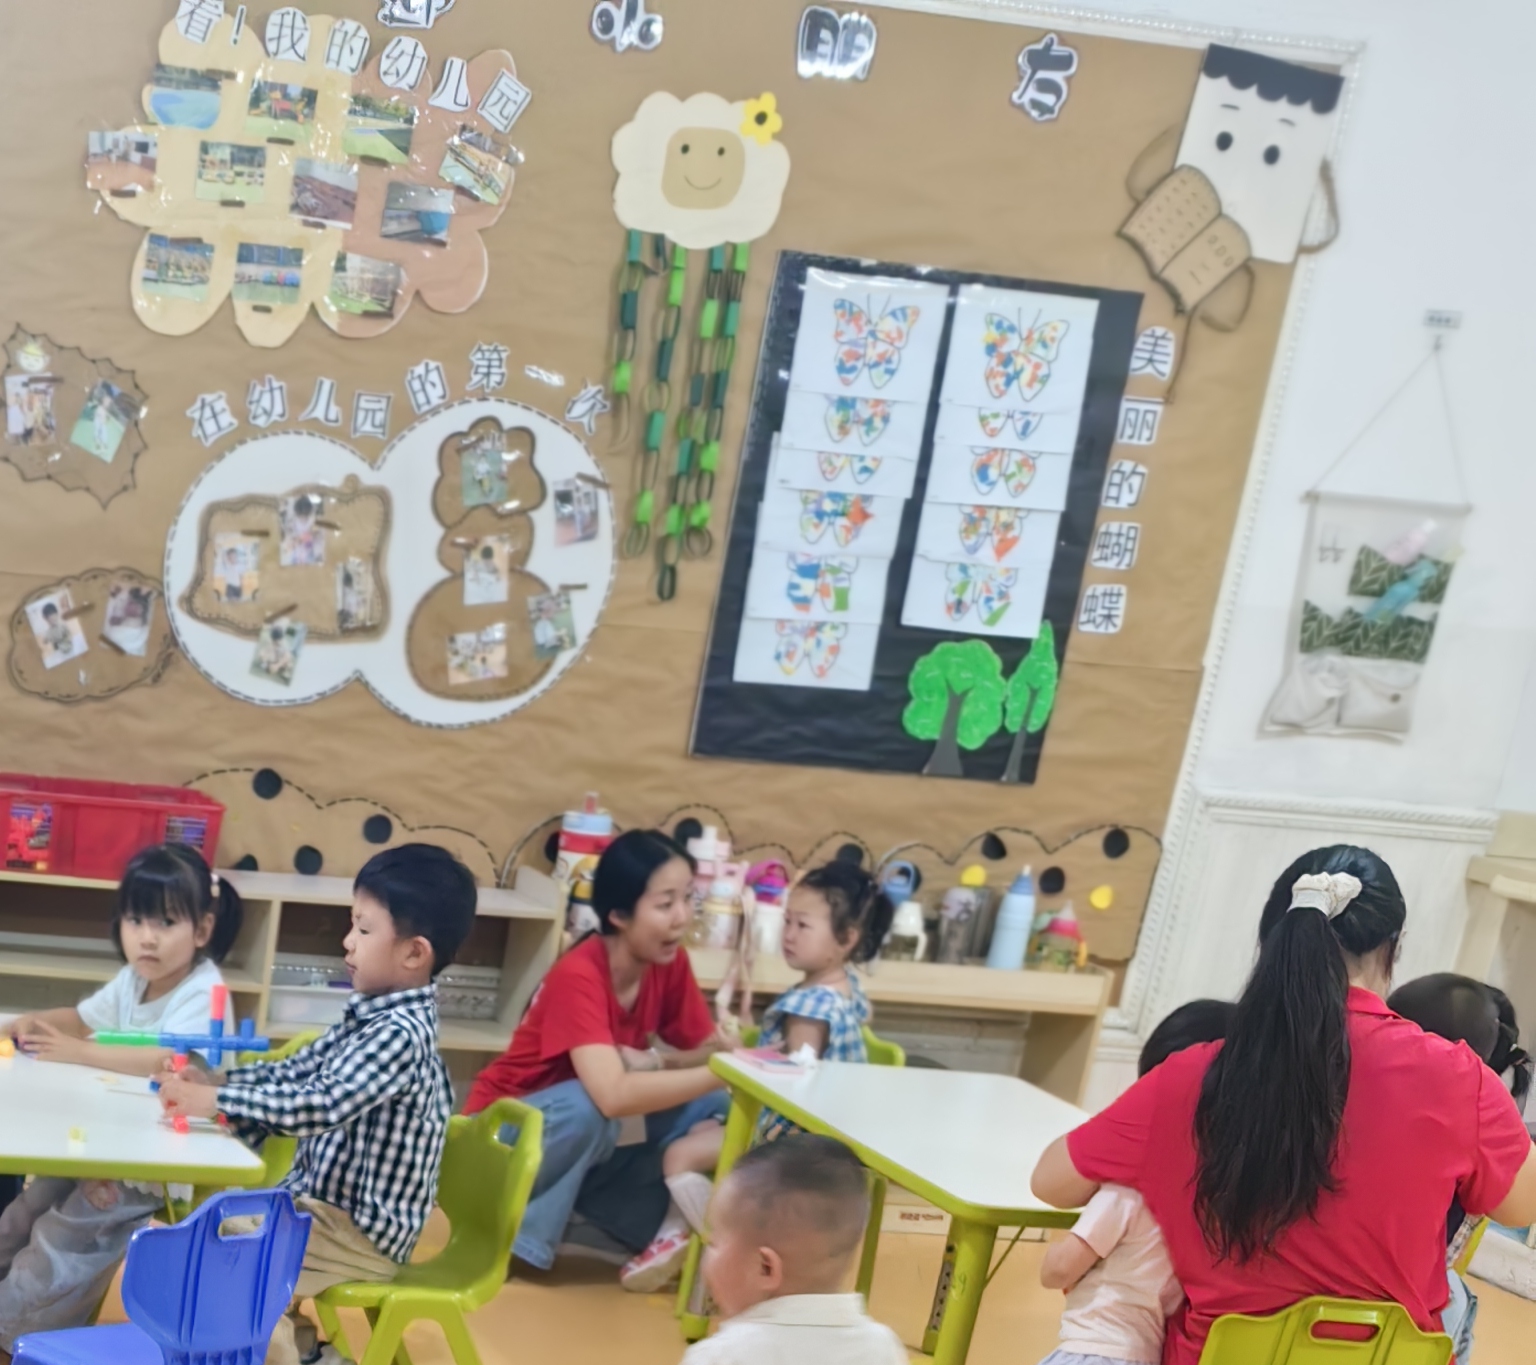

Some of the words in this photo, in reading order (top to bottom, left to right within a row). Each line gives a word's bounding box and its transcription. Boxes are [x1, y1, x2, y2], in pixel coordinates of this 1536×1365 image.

[190, 344, 608, 441] 在幼儿园的第一次
[1080, 328, 1173, 632] 美丽的蝴蝶
